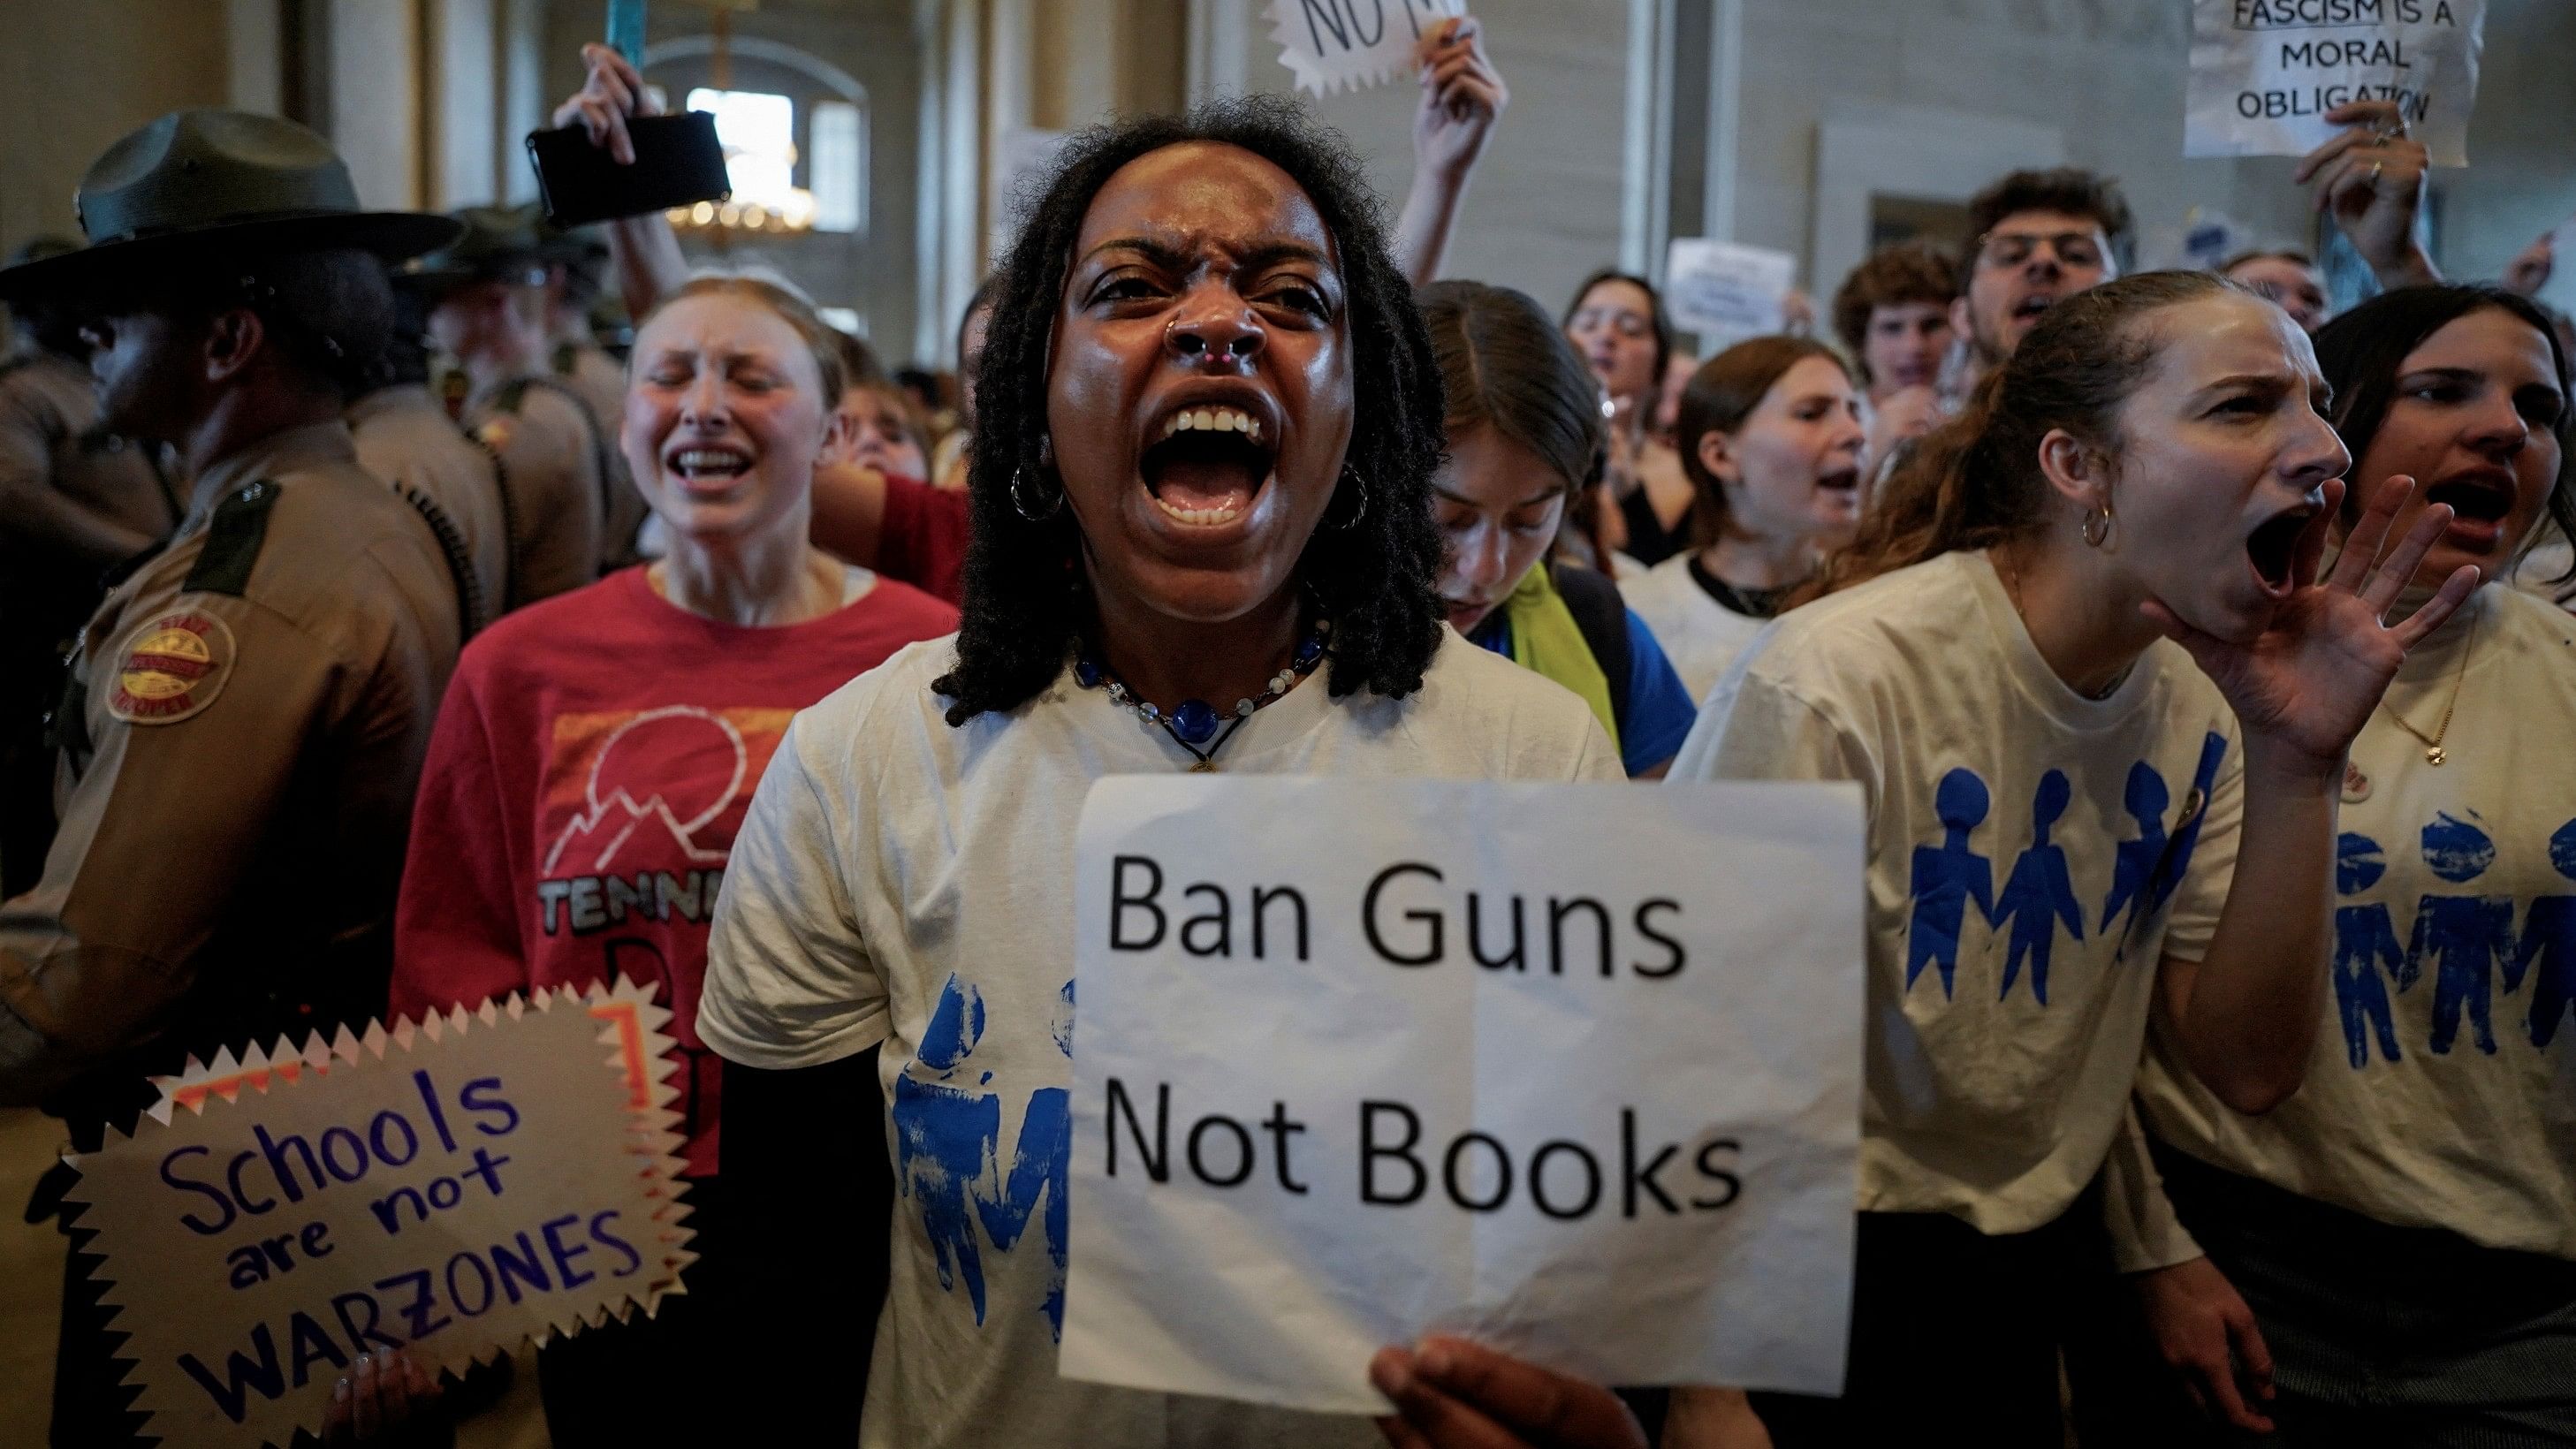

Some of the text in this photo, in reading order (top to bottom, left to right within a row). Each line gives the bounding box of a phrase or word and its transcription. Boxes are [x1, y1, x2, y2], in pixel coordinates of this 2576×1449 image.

[2233, 0, 2456, 27] FASCISM IS A
[2281, 39, 2413, 69] MORAL
[1109, 853, 1687, 982] Ban Guns
[159, 1068, 521, 1235] Schools
[225, 1146, 511, 1290] are not
[1105, 1076, 1744, 1223] Not Books
[177, 1210, 642, 1425] WARZONES
